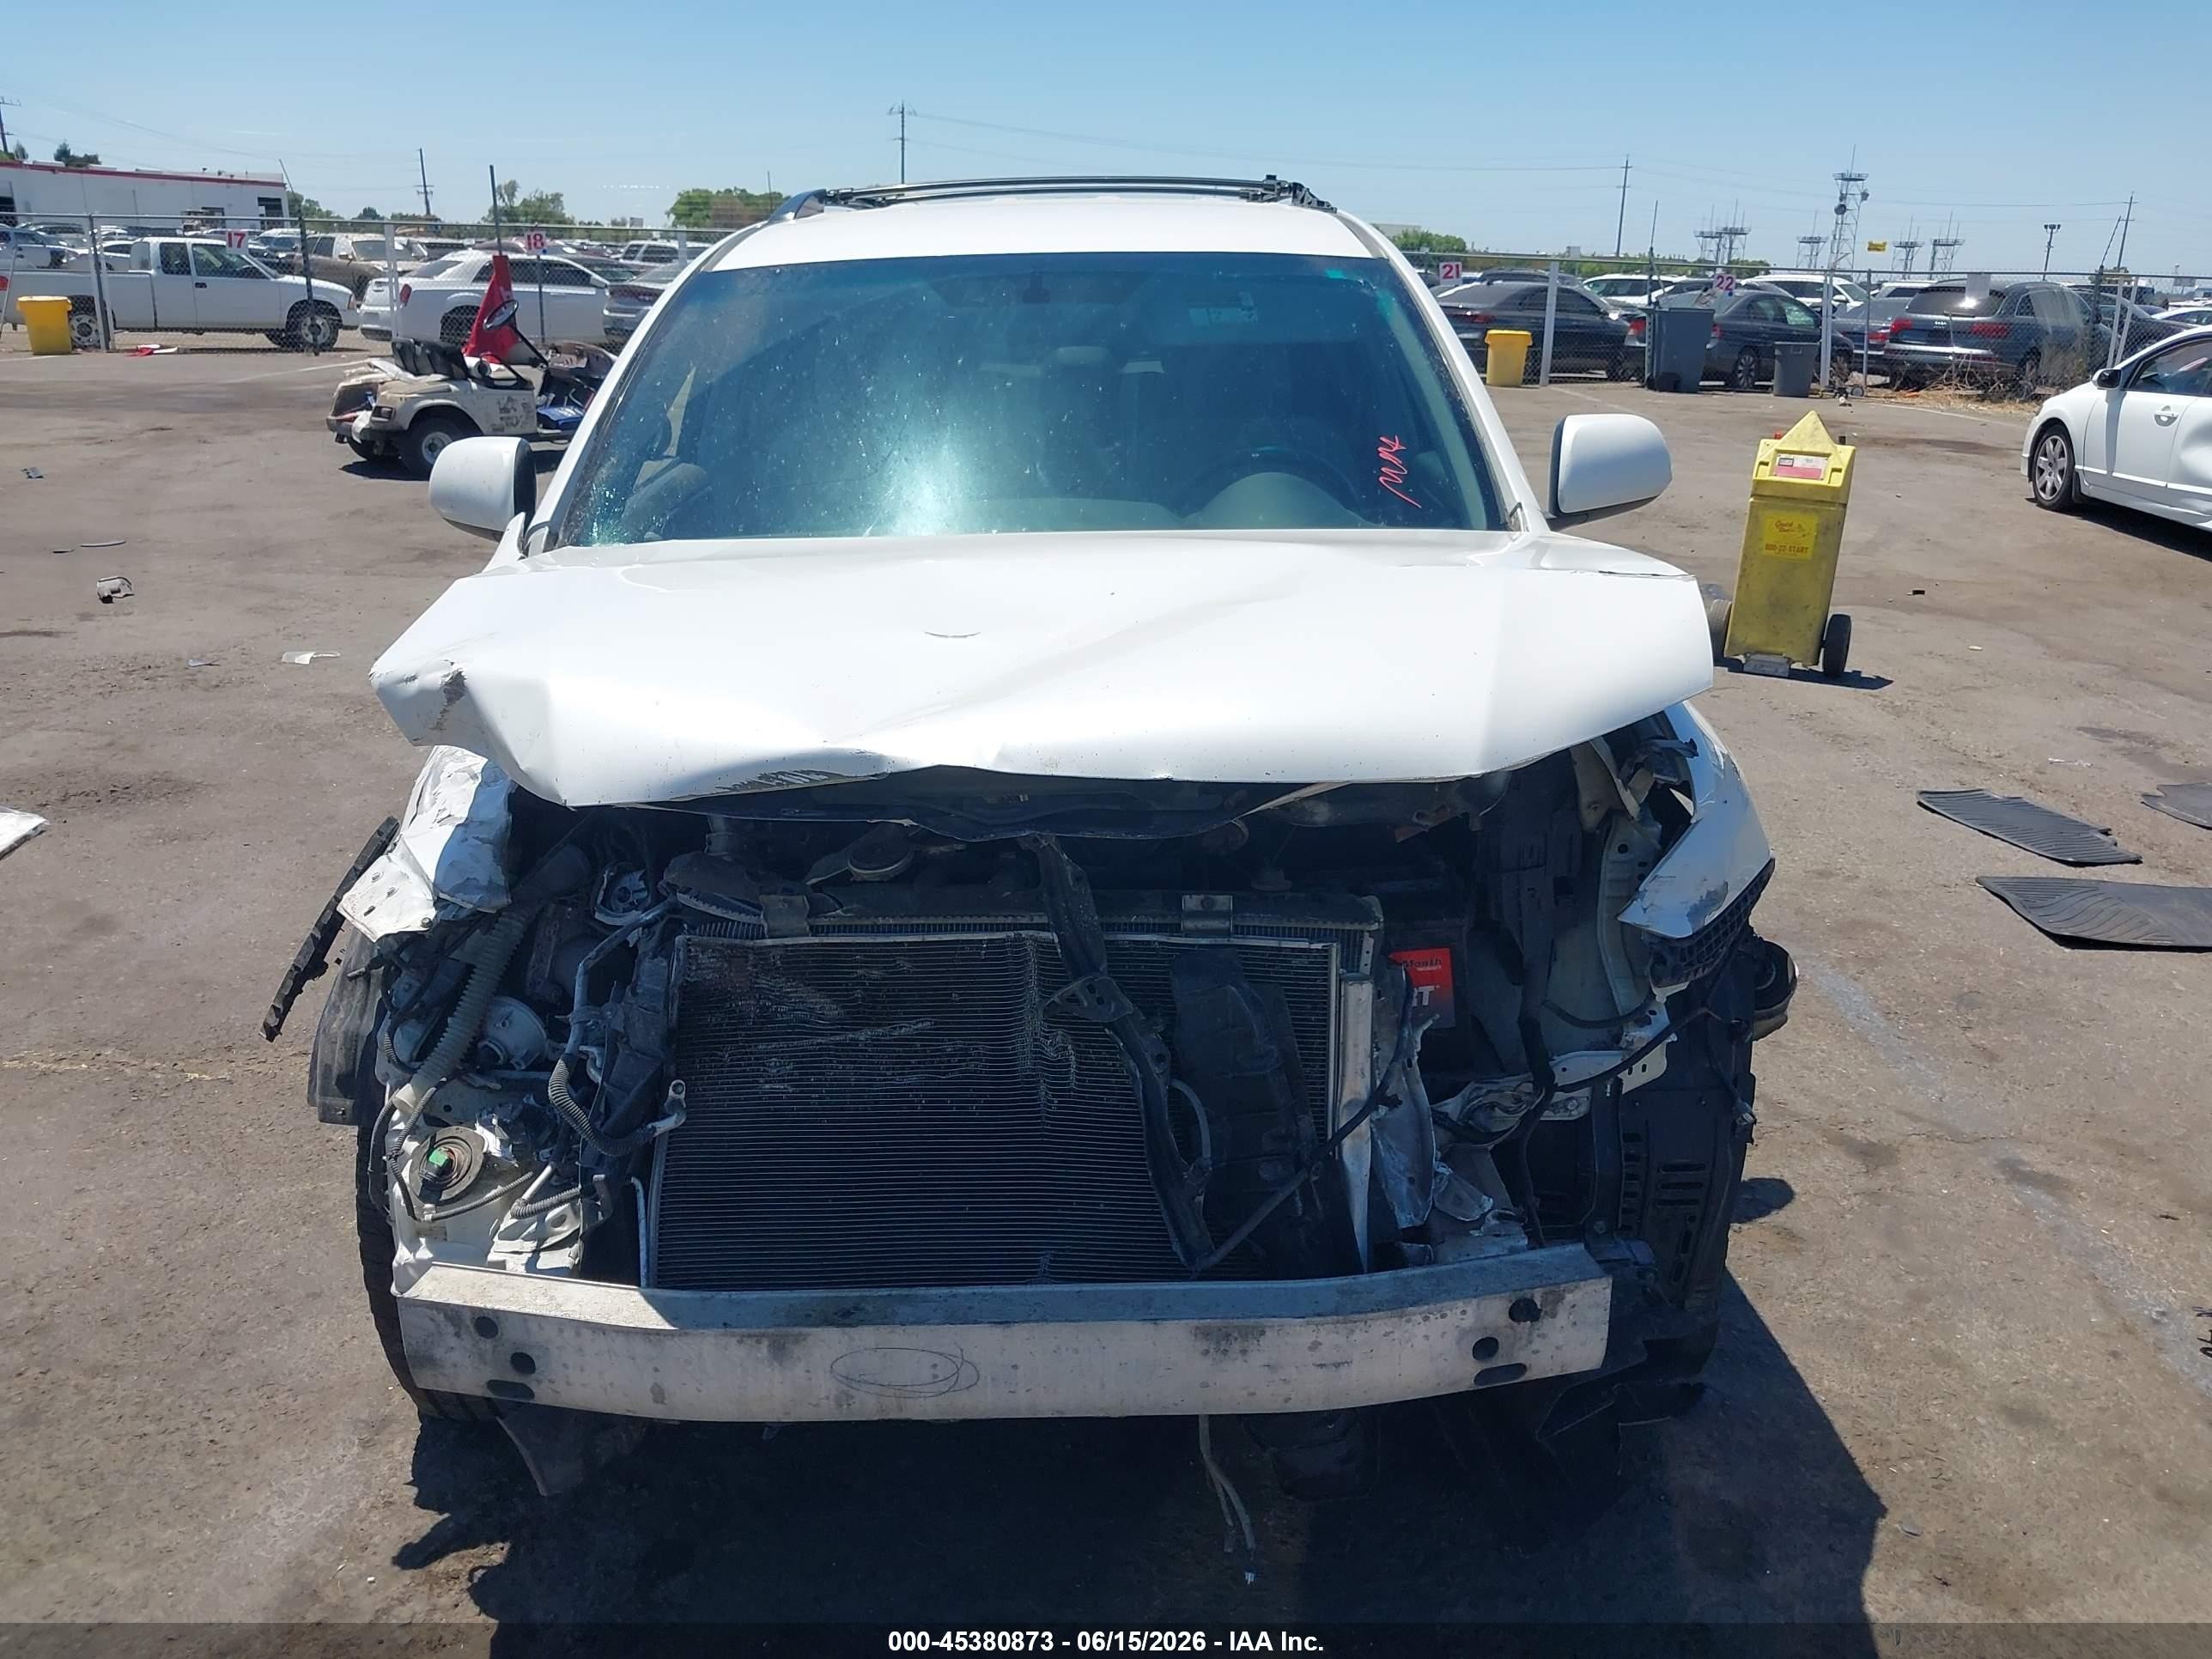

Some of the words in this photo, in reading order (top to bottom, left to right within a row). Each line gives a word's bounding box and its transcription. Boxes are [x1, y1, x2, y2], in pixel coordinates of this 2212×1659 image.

[228, 232, 246, 248] 17
[526, 233, 544, 250] 18
[1443, 264, 1461, 279] 21
[1717, 275, 1734, 291] 22
